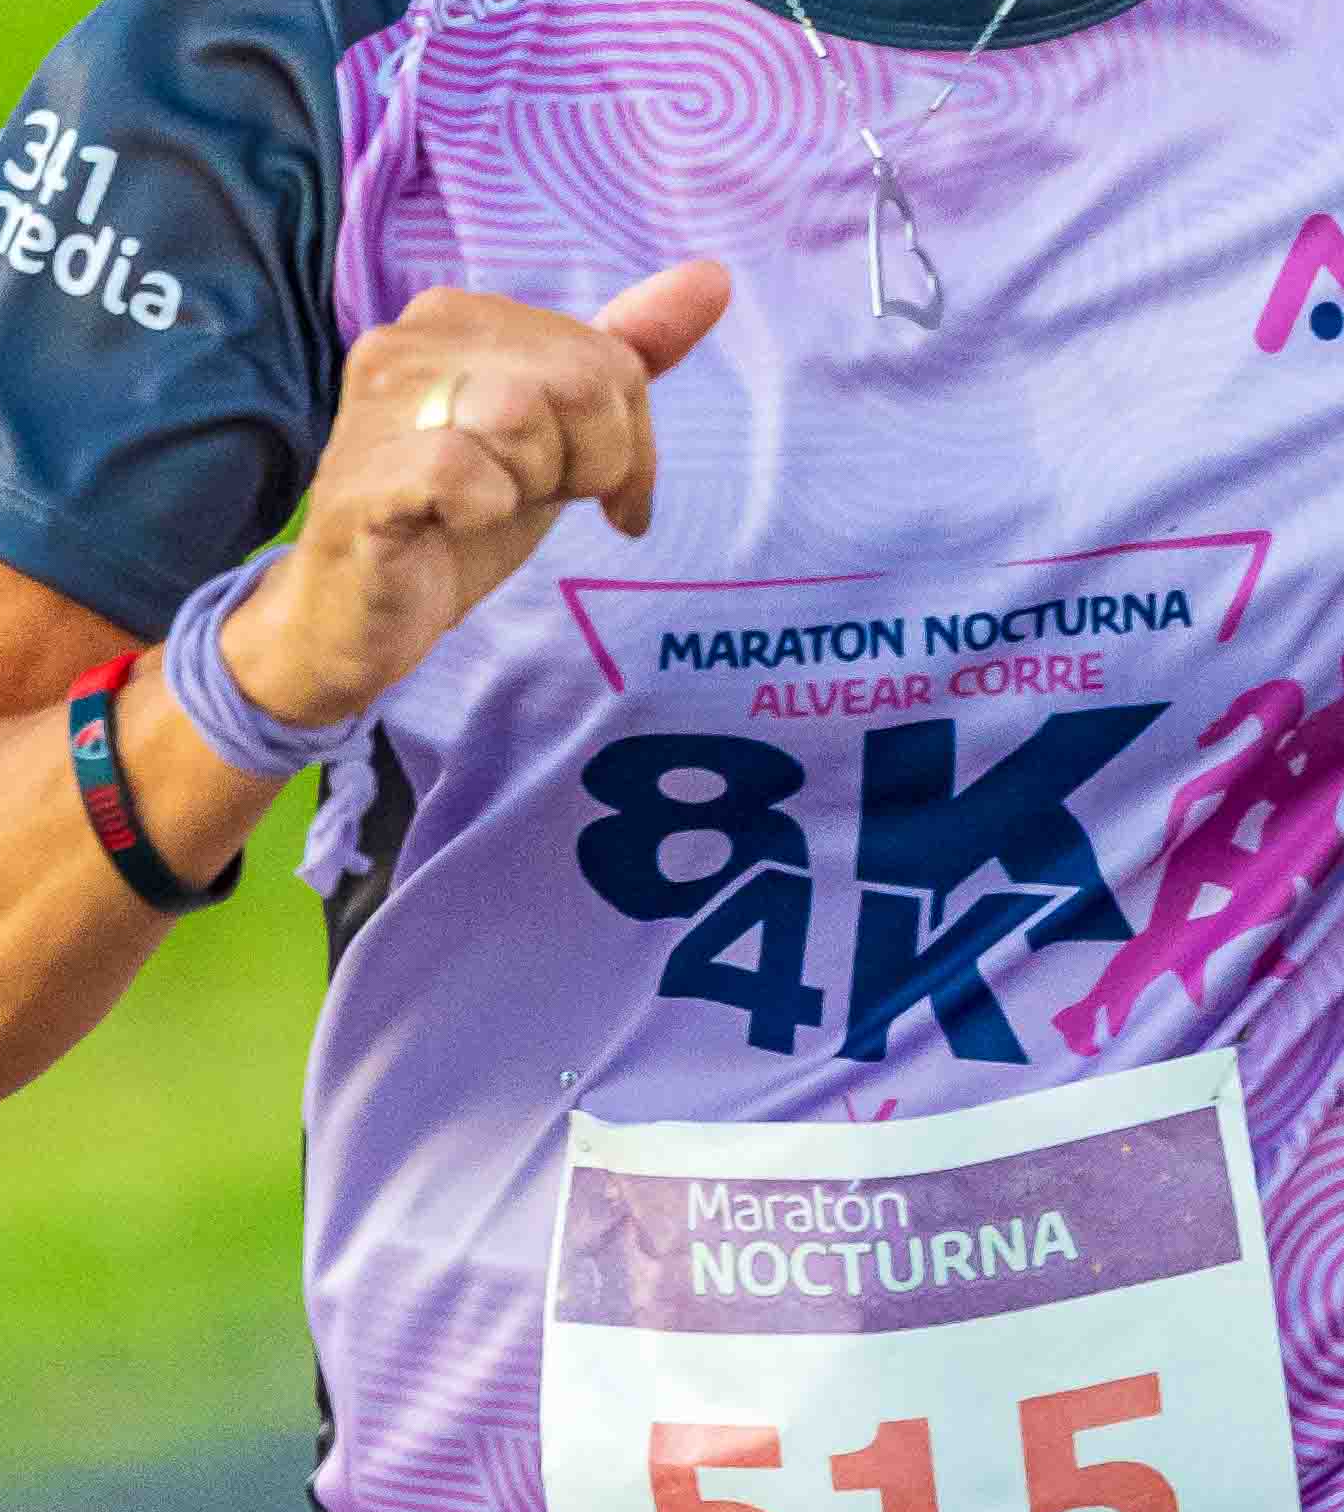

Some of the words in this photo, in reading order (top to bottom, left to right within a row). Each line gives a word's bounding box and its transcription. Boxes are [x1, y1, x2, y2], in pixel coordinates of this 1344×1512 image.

[659, 615, 906, 672] MARATON
[925, 589, 1193, 657] NOCTURNA
[749, 673, 932, 720] ALVEAR
[947, 651, 1105, 698] CORRE
[657, 874, 1033, 1066] 4K
[687, 1177, 910, 1233] Maratón
[690, 1210, 1080, 1296] NOCTURNA
